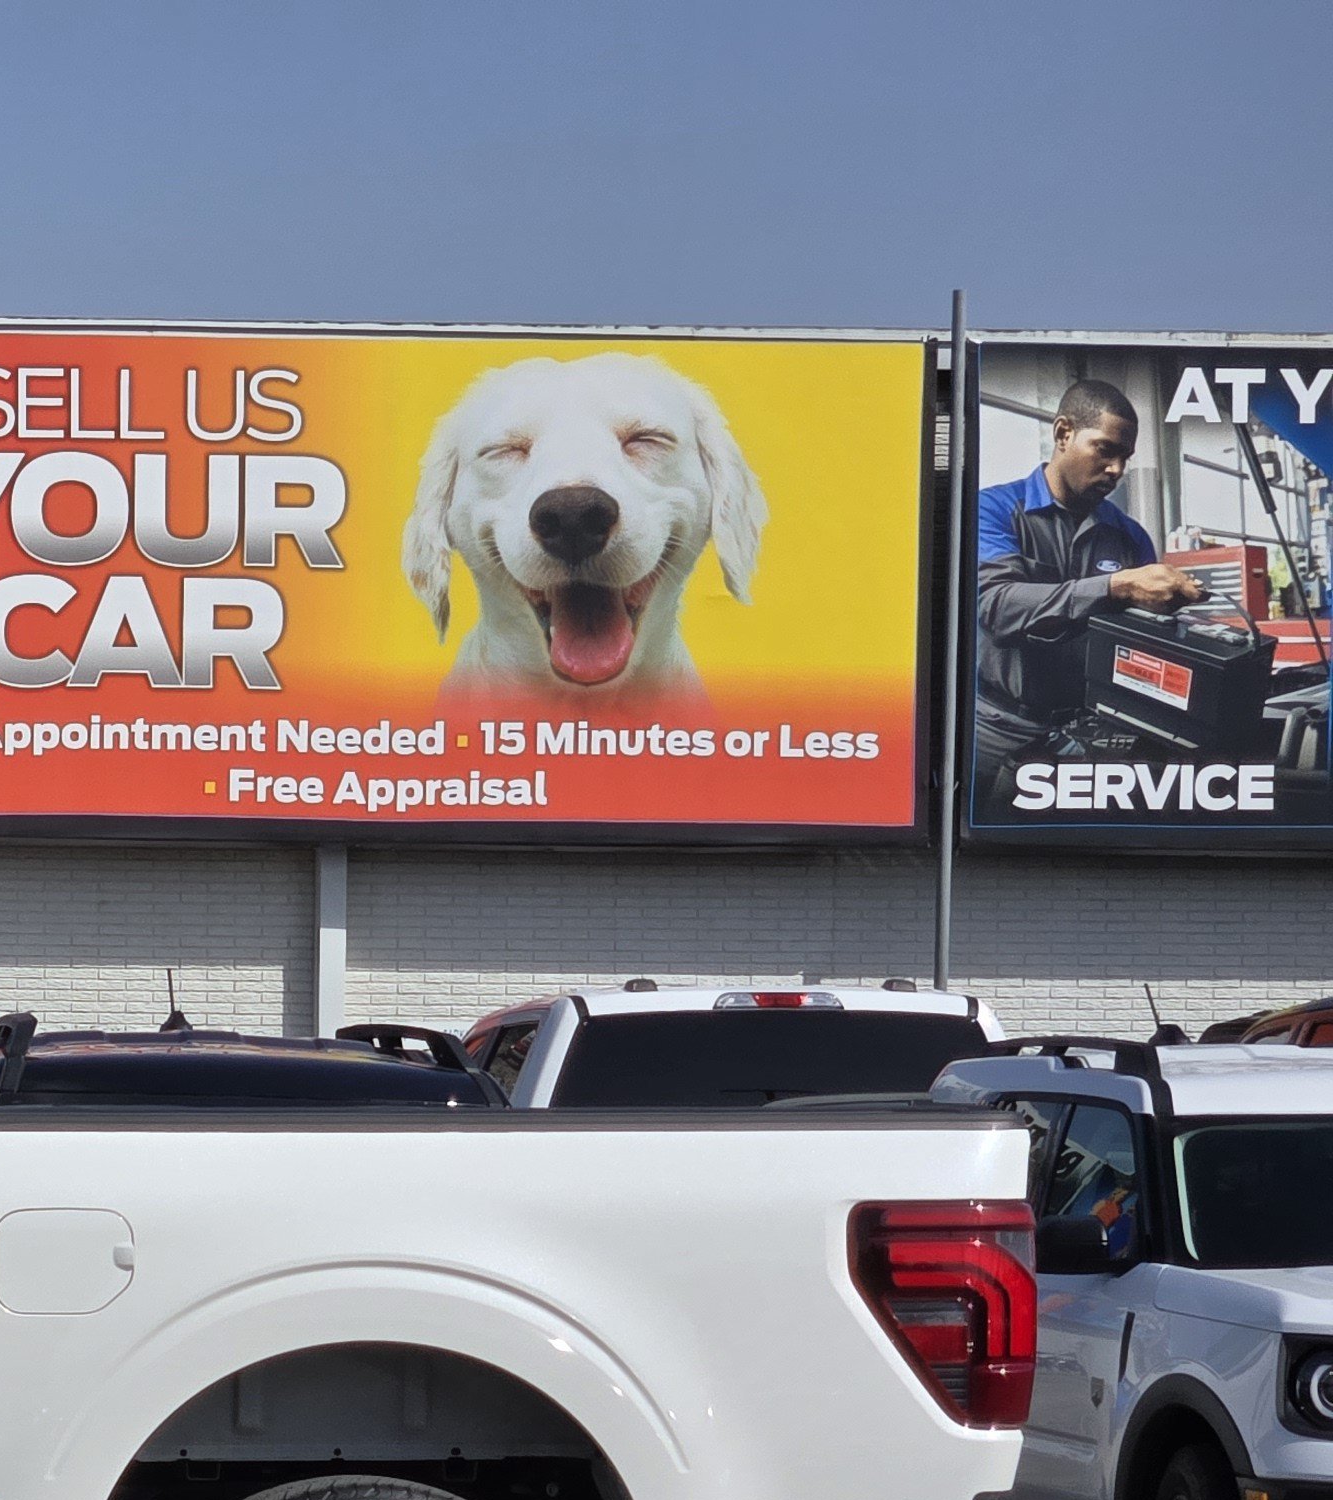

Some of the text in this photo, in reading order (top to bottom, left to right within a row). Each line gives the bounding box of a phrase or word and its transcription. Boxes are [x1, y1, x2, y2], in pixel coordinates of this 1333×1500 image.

[186, 368, 302, 442] US
[1165, 367, 1266, 424] AT
[276, 719, 446, 755] Needed
[480, 721, 526, 755] 15
[535, 721, 715, 757] Minutes
[724, 729, 769, 758] or
[779, 725, 880, 759] Less
[228, 769, 548, 812] Free Appraisal
[1012, 763, 1275, 811] SERVICE
